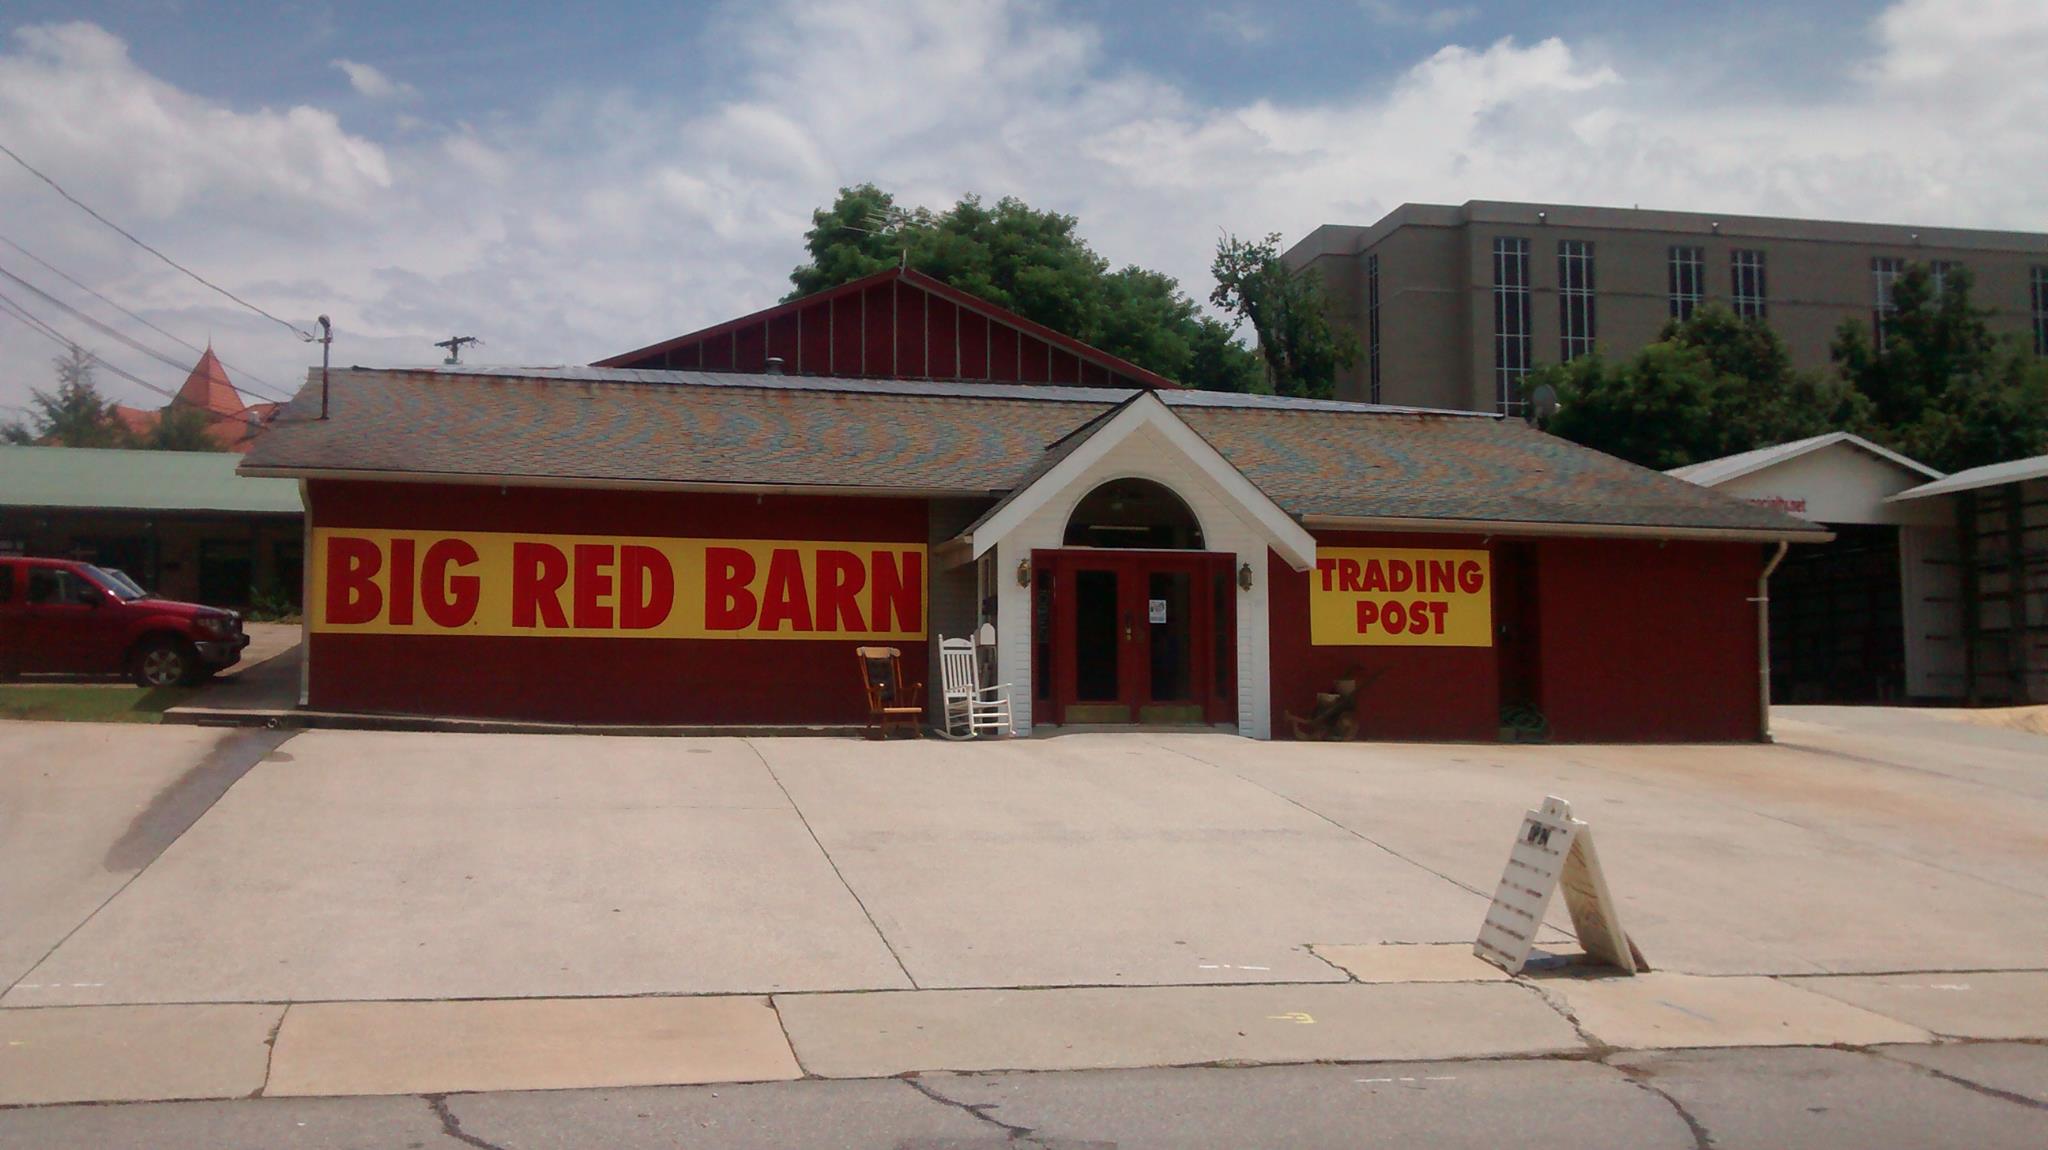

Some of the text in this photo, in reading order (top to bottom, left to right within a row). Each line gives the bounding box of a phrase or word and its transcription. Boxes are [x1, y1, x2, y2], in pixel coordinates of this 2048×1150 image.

[325, 536, 922, 633] BIG RED BARN
[1316, 558, 1484, 594] TRADING
[1356, 600, 1448, 635] POST
